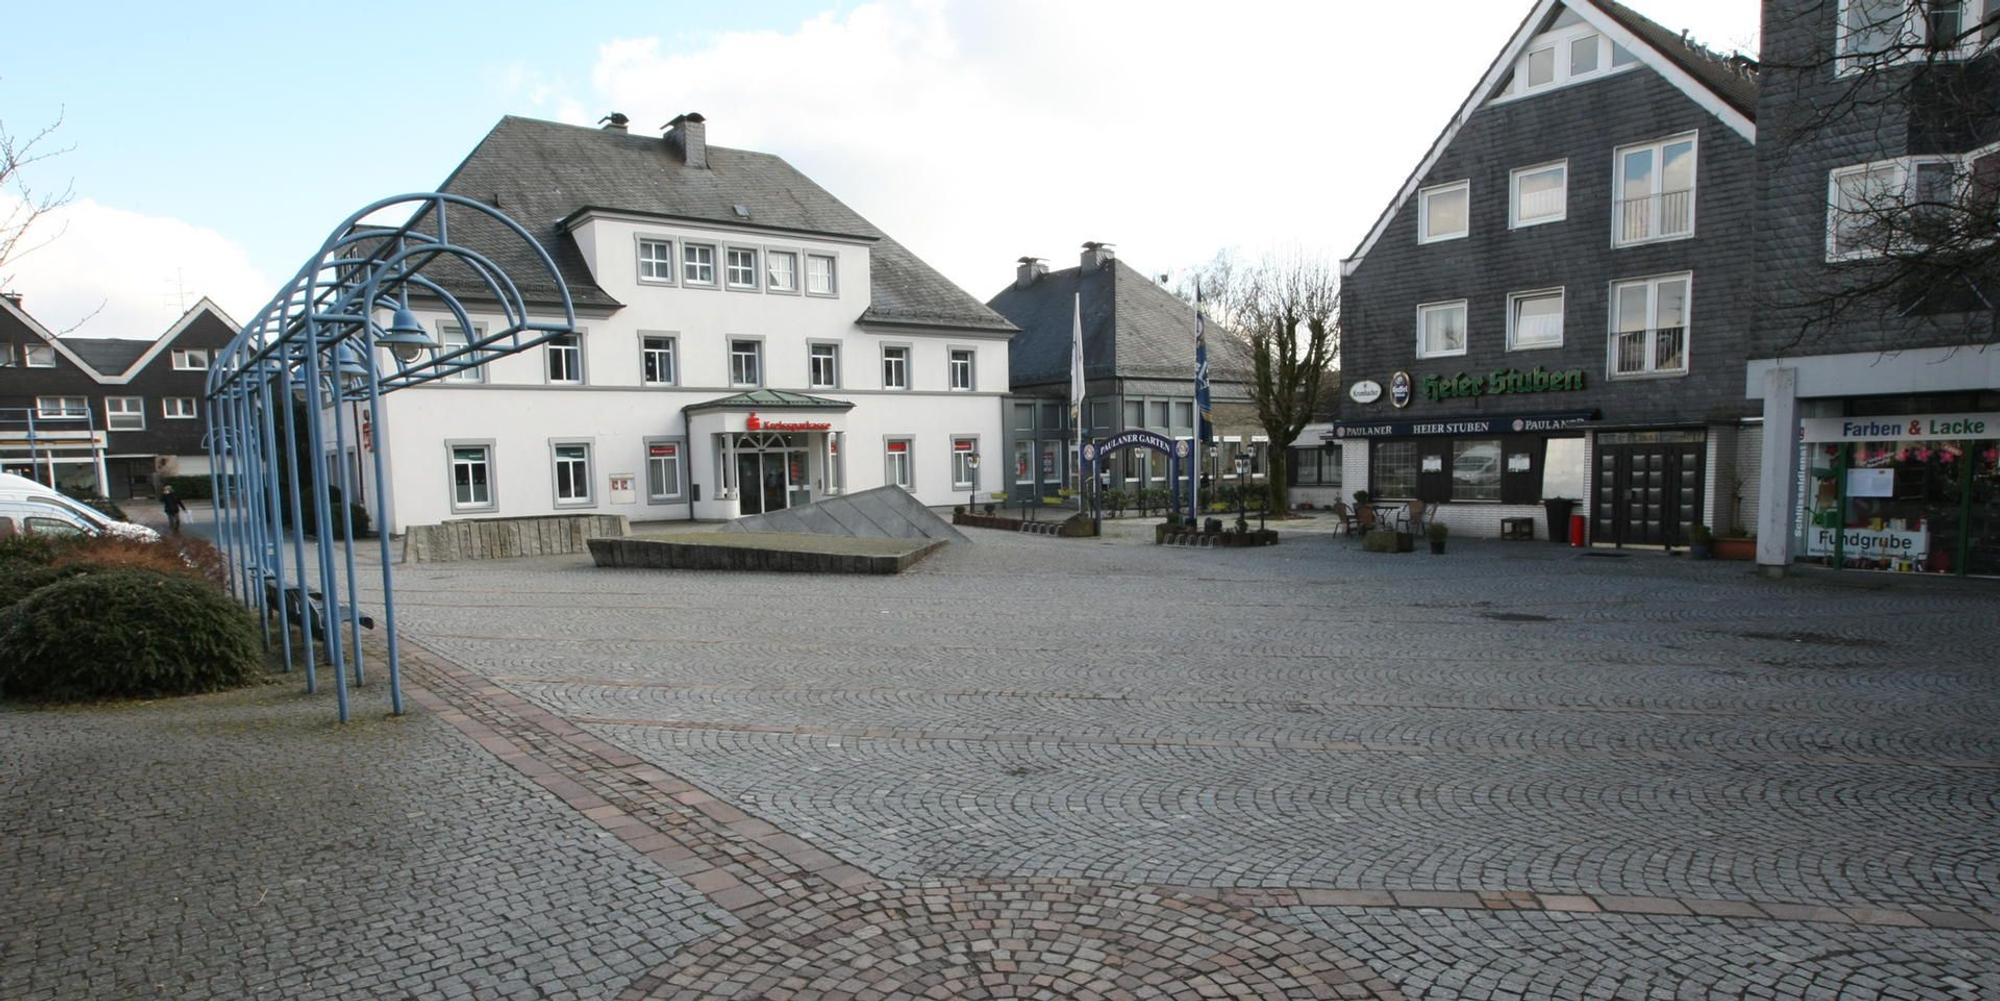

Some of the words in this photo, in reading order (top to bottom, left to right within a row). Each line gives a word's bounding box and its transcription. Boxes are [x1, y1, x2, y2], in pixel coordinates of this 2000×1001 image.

[1488, 366, 1583, 394] Stuben
[1346, 425, 1392, 437] PAULANER
[1413, 423, 1444, 434] HEIER
[1446, 421, 1490, 433] STUBEN
[1843, 422, 1901, 437] Farben
[1908, 420, 1921, 435] &
[1929, 419, 1985, 434] Lacke
[1100, 434, 1138, 456] PAULANER
[1139, 434, 1170, 453] GARTEN
[1819, 530, 1912, 550] Fundgrube
